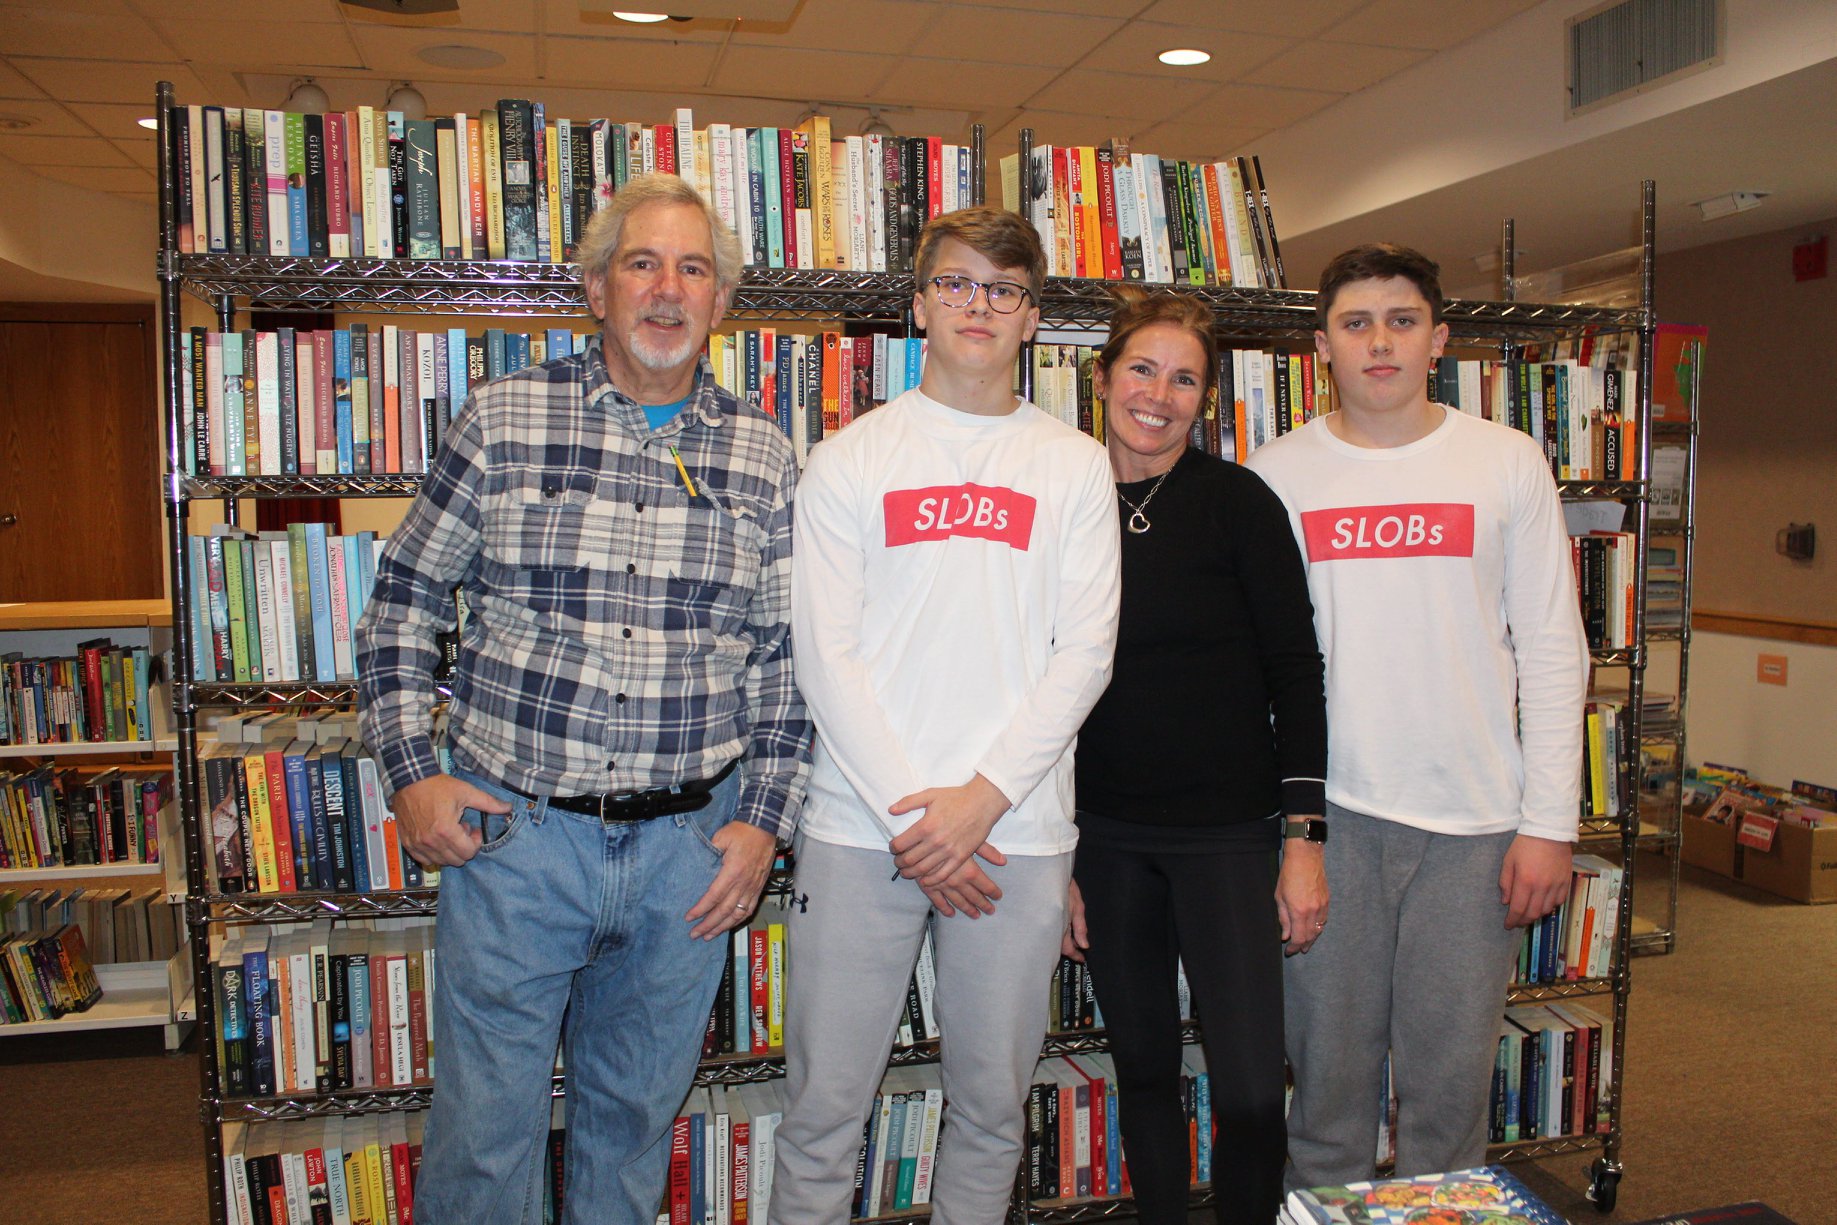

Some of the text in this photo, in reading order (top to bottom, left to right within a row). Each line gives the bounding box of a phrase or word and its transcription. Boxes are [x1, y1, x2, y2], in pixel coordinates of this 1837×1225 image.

[286, 118, 294, 168] LESSONS
[504, 110, 516, 158] HENRY VIII
[680, 120, 692, 169] THE HEALING
[269, 136, 282, 169] prep
[310, 135, 318, 176] GEISHA
[408, 128, 432, 177] Joseph
[472, 146, 480, 183] MARTIAN
[572, 134, 580, 177] INSTINCT
[580, 143, 590, 177] DEATH
[630, 156, 640, 180] LIFE
[850, 151, 858, 188] Husband's
[885, 148, 894, 180] SHAARA
[716, 140, 730, 222] mary kay andrews
[796, 154, 806, 208] KATE JACOBS
[1102, 164, 1110, 182] JODI
[1126, 169, 1134, 210] THROUGH
[473, 190, 481, 212] ANDY
[818, 145, 832, 242] IGGULDEN WARS ROSES
[1104, 184, 1114, 218] PICOULT
[1260, 188, 1269, 208] T-REX
[888, 188, 900, 260] GODS AND GENERALS
[1234, 190, 1248, 236] BOUND
[1244, 190, 1270, 276] T-REX TURPIN
[284, 369, 290, 379] IN
[436, 336, 448, 394] ANNE PERRY
[470, 345, 478, 380] GREGORY
[808, 344, 816, 394] CHANEL
[196, 392, 204, 408] MAN
[824, 399, 838, 412] THE
[824, 412, 839, 422] GUN
[197, 412, 205, 430] JOHN
[1606, 374, 1616, 470] GIMENEZ ACCUSED
[198, 440, 206, 461] CARRÉ
[914, 493, 1008, 530] SLOBs
[1331, 514, 1444, 549] SLOBs
[258, 558, 270, 614] Unwritten
[312, 538, 324, 612] BROKEN YOU
[220, 632, 229, 660] HARRY
[272, 773, 282, 801] PARIS
[323, 770, 344, 868] DESCENT TIM JOHNSTON
[755, 936, 763, 956] JASON
[335, 960, 344, 996] Captivated
[755, 958, 763, 990] MATTHEWS
[1086, 972, 1094, 1003] endell
[226, 970, 242, 1038] DARK DETECTIVES
[252, 970, 262, 1018] FLOATING
[336, 997, 344, 1006] by
[353, 969, 364, 1024] JODI PICOULT
[910, 994, 919, 1019] ROAD
[182, 1012, 188, 1020] Z
[756, 1019, 764, 1047] SPARROW
[254, 1022, 265, 1047] BOOK
[336, 1046, 344, 1064] SYLVIA
[1032, 1092, 1040, 1102] AM
[890, 1108, 902, 1156] JODI PICOULT
[907, 1104, 919, 1152] JODI PICOULT
[674, 1121, 688, 1186] Wolf Hall
[917, 1106, 938, 1190] JAMES PATTERSON GUILTY WIVES
[1032, 1144, 1040, 1166] TERRY
[234, 1158, 245, 1184] PHILIP ROTH
[307, 1154, 316, 1182] LAWTON
[314, 1158, 322, 1174] JOHN
[735, 1144, 748, 1200] JAMES PATTERSON
[1032, 1166, 1040, 1187] HAYES
[330, 1158, 344, 1216] TRUE NORTH
